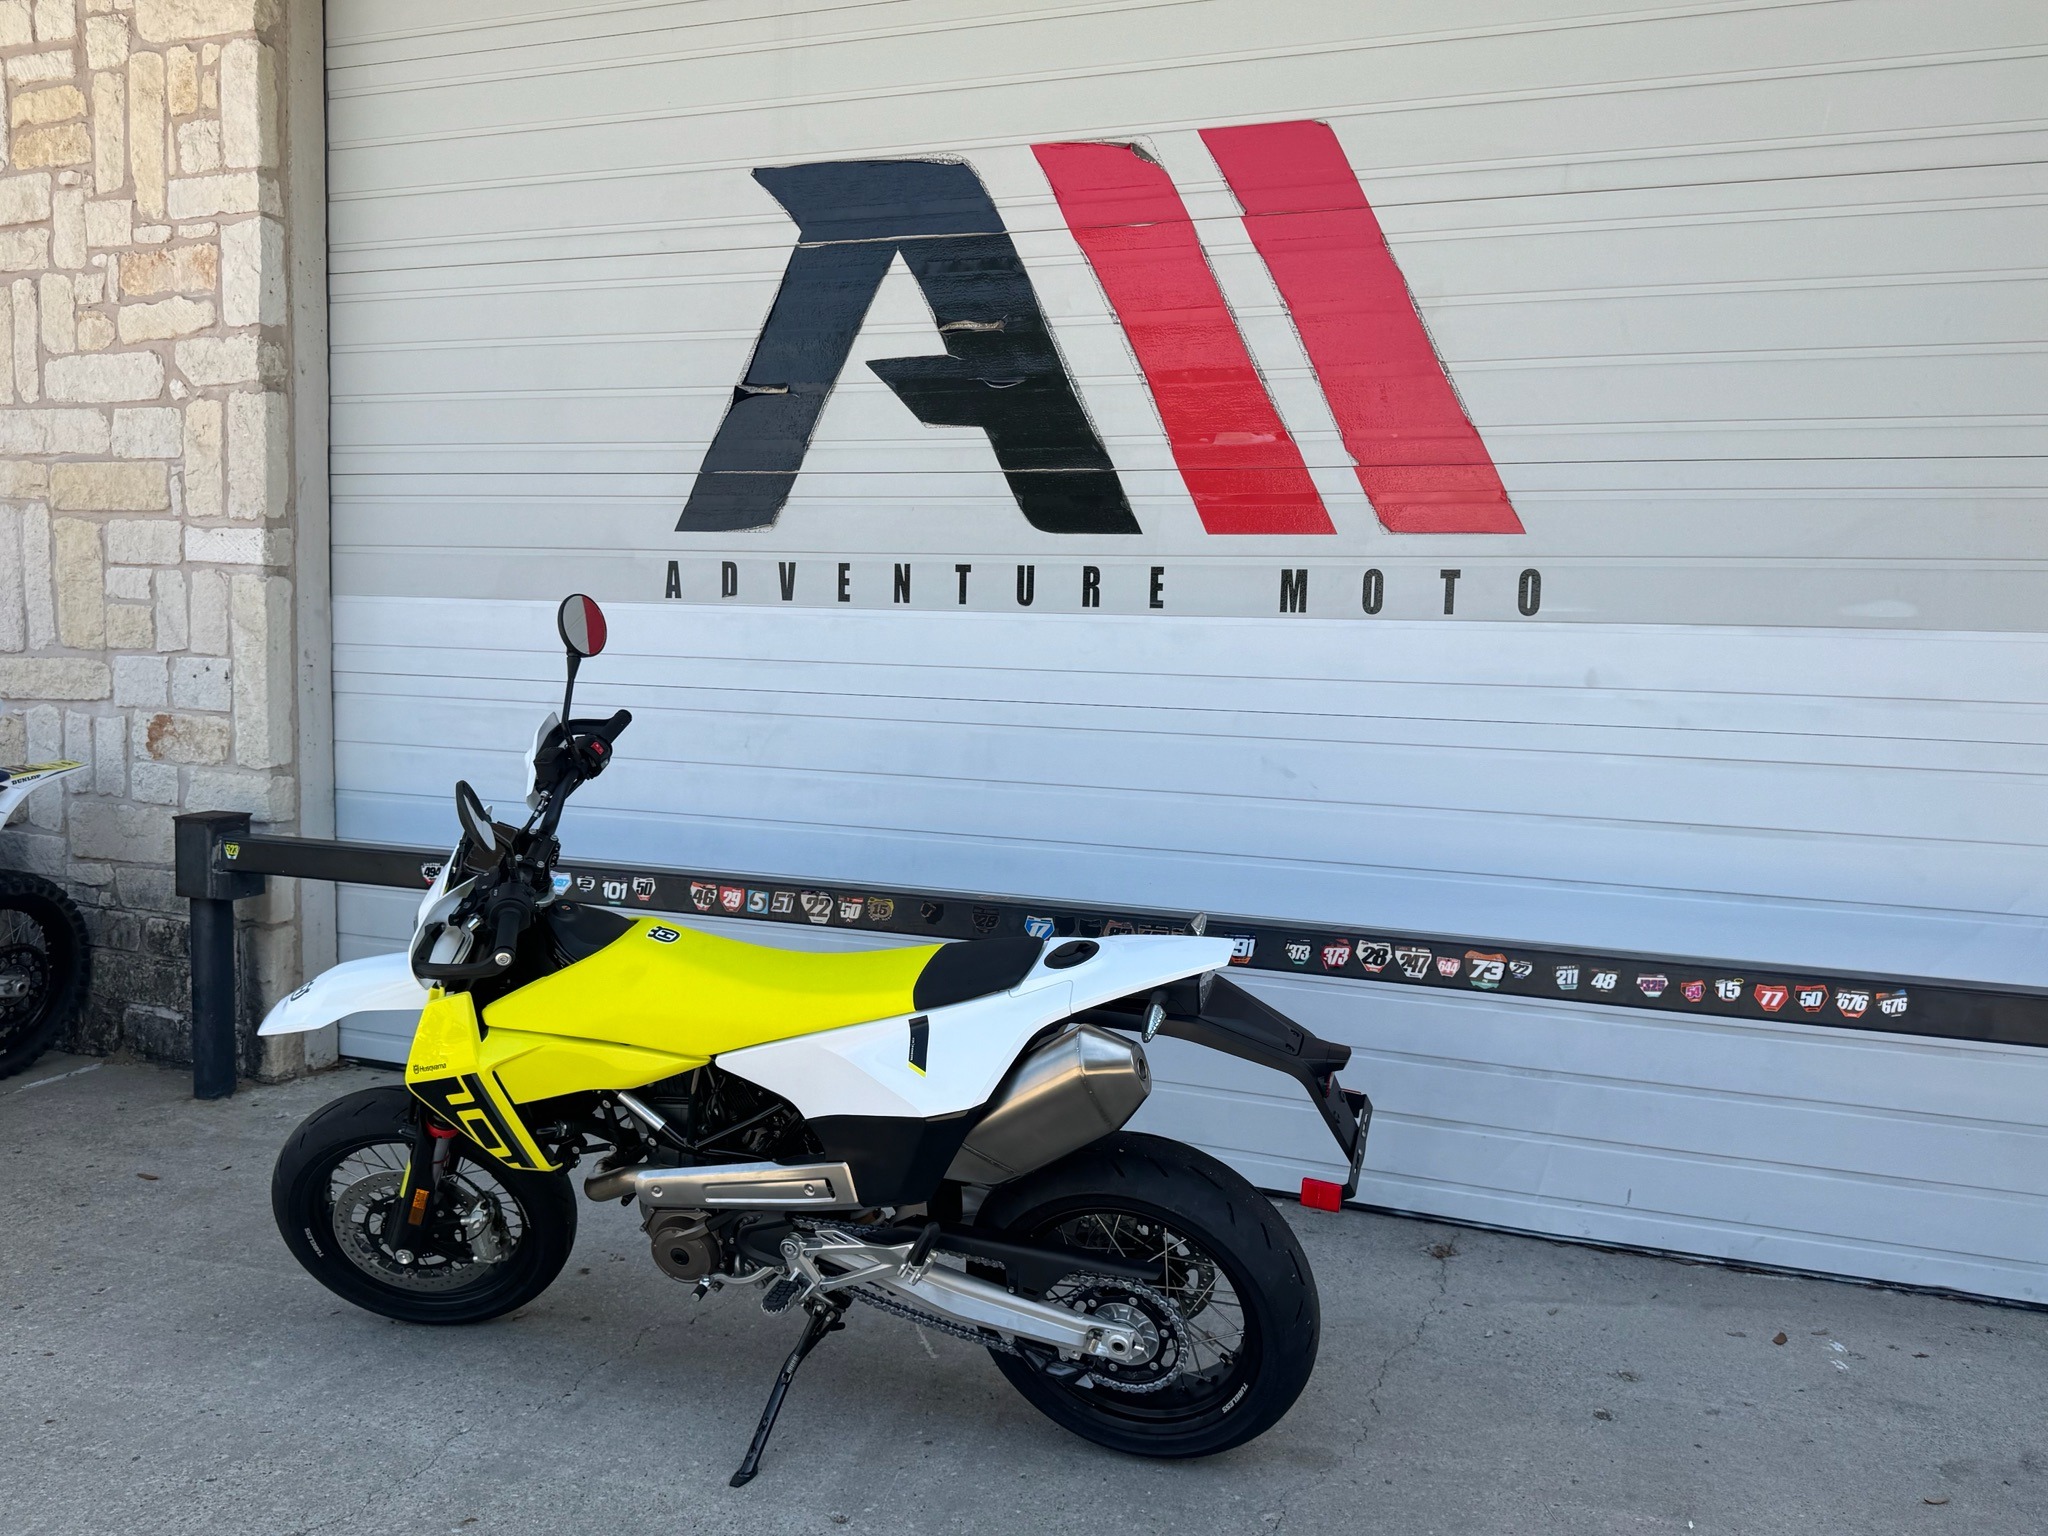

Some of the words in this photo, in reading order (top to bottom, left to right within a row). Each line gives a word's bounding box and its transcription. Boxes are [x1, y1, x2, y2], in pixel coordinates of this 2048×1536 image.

[665, 560, 1165, 609] ADVENTURE
[1279, 568, 1542, 617] MOTO
[11, 774, 41, 786] DUNLOP
[602, 881, 628, 900] 101
[636, 881, 653, 896] 50
[693, 889, 715, 906] 46
[723, 891, 741, 908] 29
[750, 892, 766, 911] 5
[772, 892, 795, 913] 51
[806, 896, 829, 917] 22
[840, 902, 862, 919] 50
[873, 904, 888, 916] 15
[1029, 923, 1050, 938] 17
[1323, 947, 1350, 965] 373
[1361, 946, 1389, 967] 28
[1400, 953, 1430, 974] 247
[1469, 959, 1505, 981] 73
[1512, 963, 1530, 975] 22
[1555, 969, 1579, 985] 211
[1590, 973, 1618, 990] 48
[1685, 985, 1701, 998] 54
[1715, 982, 1741, 1000] 15
[1761, 990, 1784, 1006] 77
[1800, 991, 1823, 1007] 50
[419, 1062, 447, 1072] Husqvarna
[1221, 1382, 1249, 1414] TUBELESS
